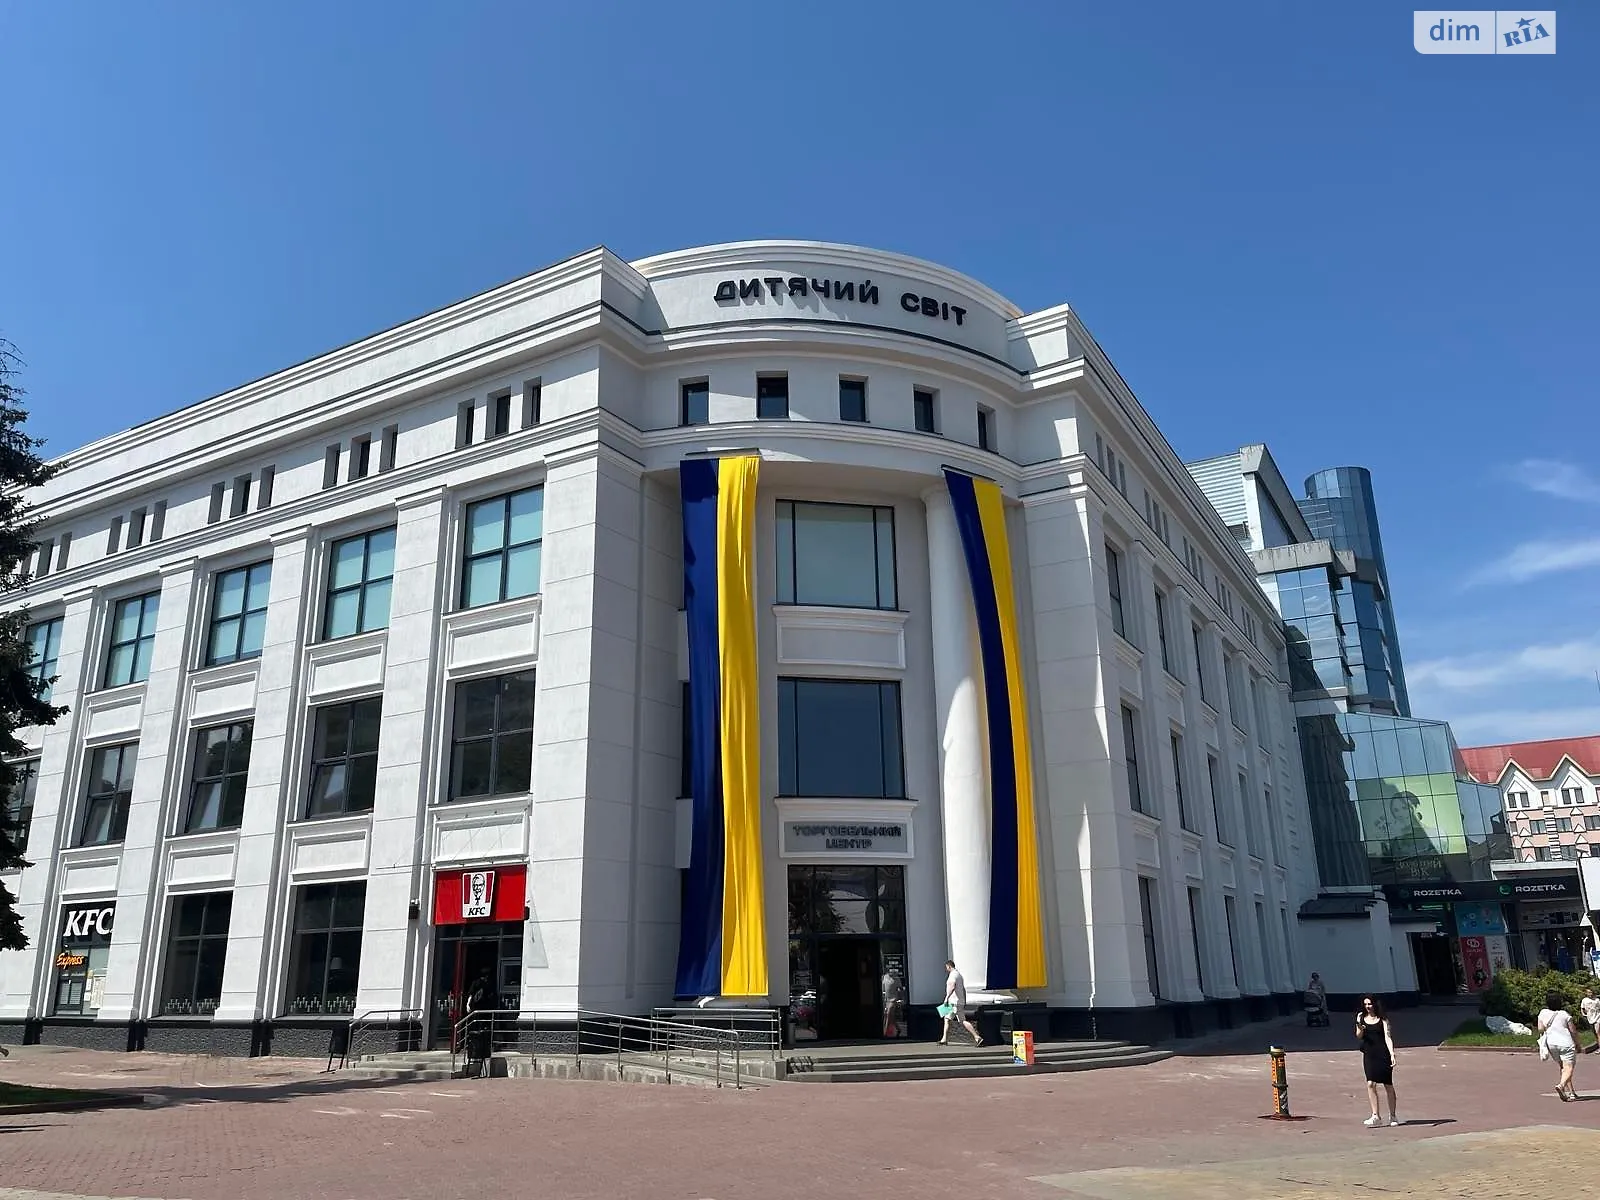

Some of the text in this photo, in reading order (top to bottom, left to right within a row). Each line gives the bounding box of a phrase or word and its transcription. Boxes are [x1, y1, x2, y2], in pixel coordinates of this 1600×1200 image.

[713, 277, 967, 326] ДИТЯЧИЙ СВІТ
[825, 838, 873, 849] ЦЕНТР
[1413, 888, 1462, 898] ROZETKA
[1515, 883, 1566, 893] ROZETKA
[468, 906, 486, 916] KFC
[63, 908, 114, 937] KFC
[57, 952, 84, 969] Express
